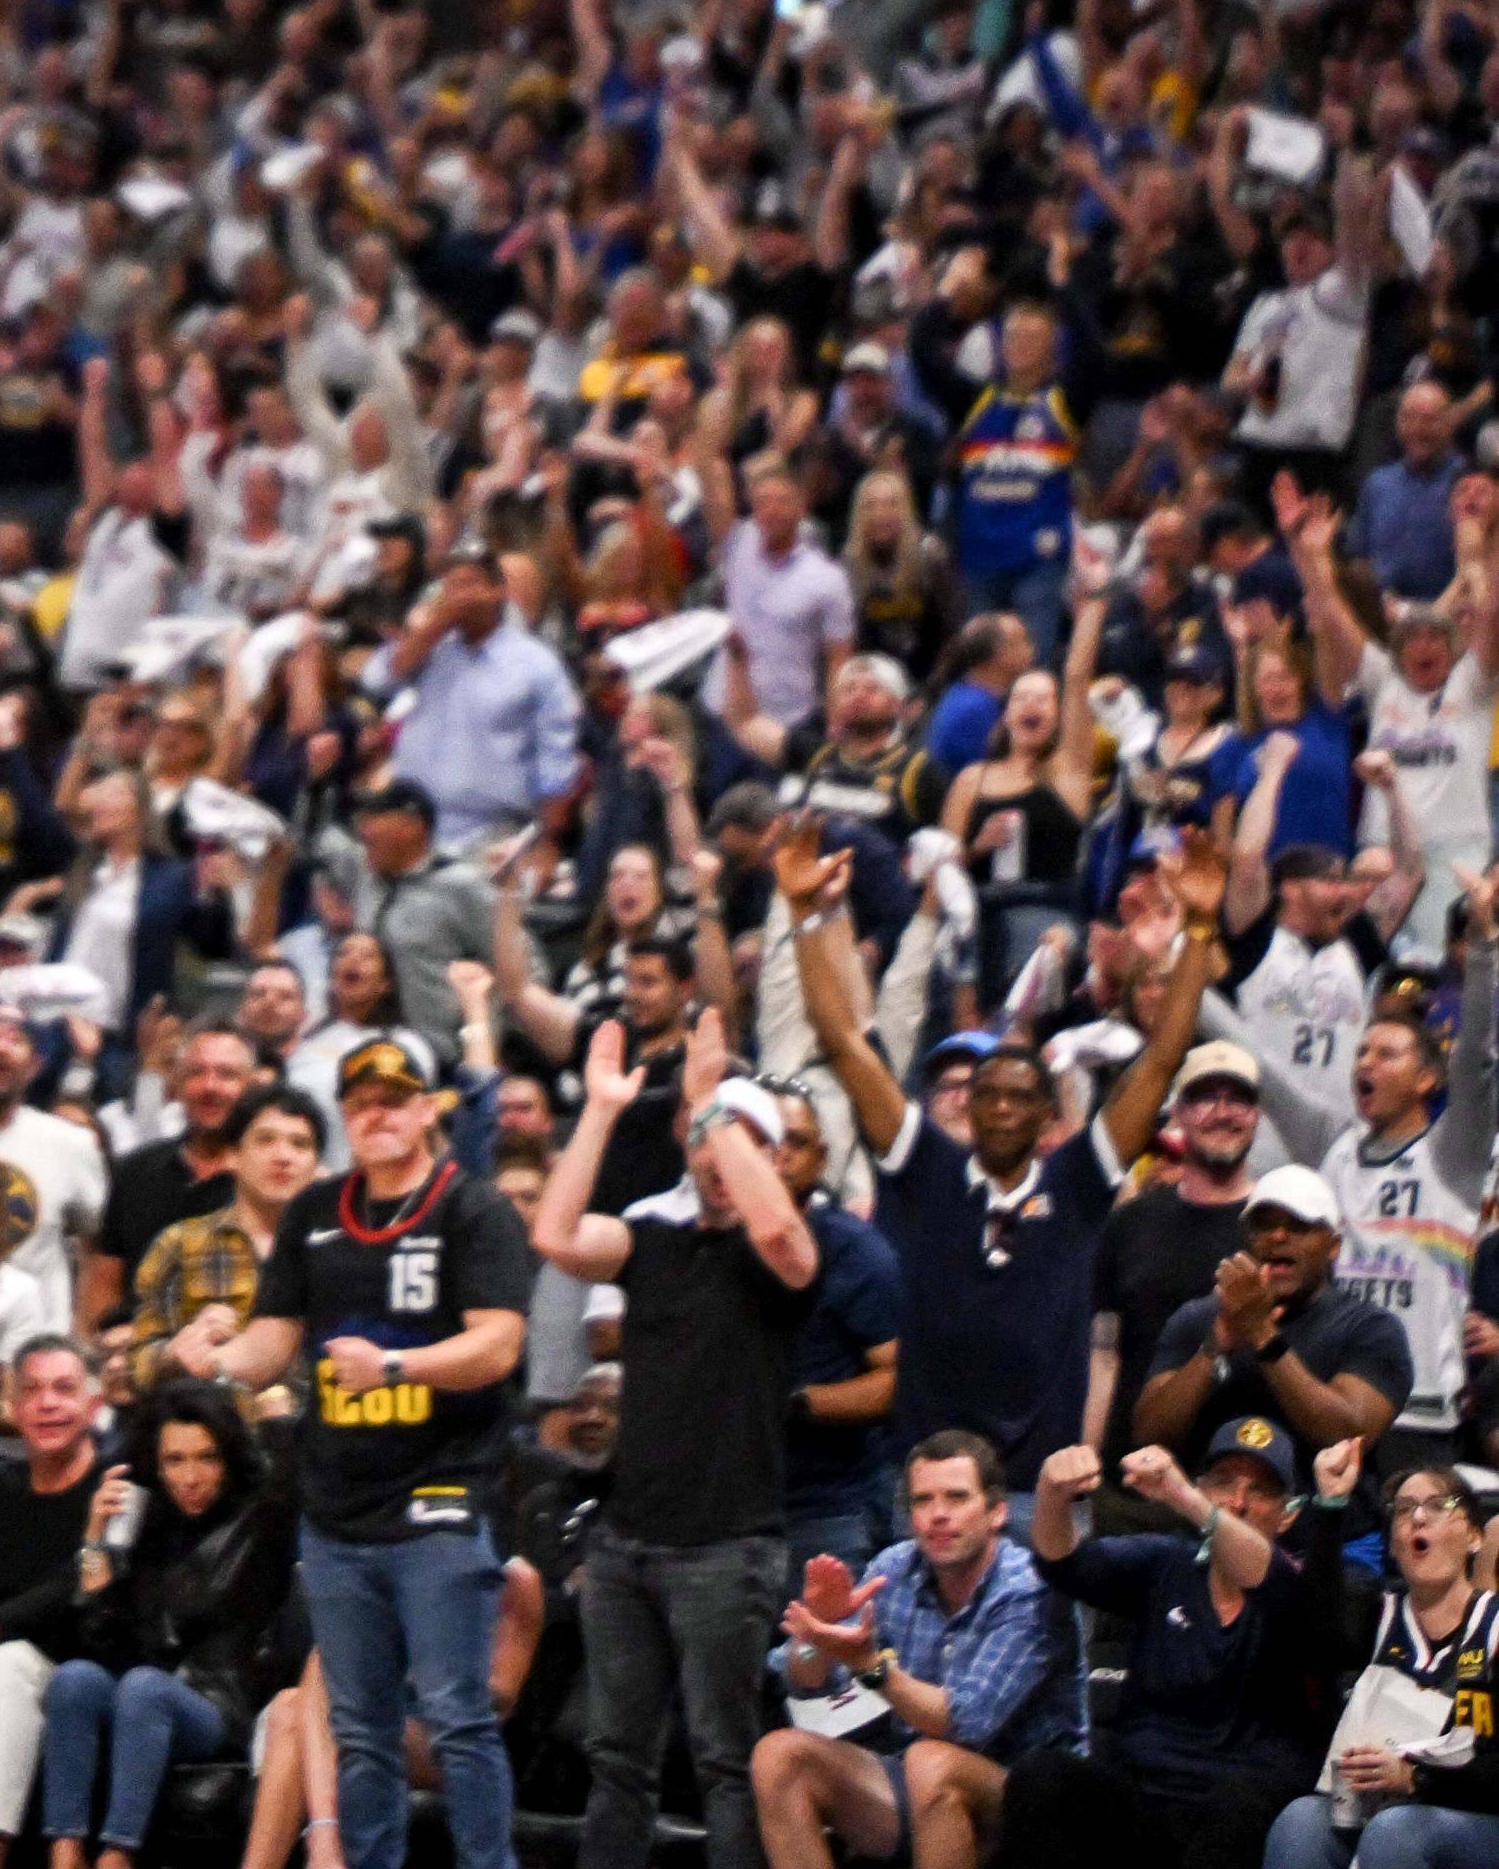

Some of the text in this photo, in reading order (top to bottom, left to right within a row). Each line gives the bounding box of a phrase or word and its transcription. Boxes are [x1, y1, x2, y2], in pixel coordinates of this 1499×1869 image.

[1292, 1025, 1336, 1068] 27
[1379, 1180, 1421, 1216] 27
[390, 1253, 438, 1312] 15
